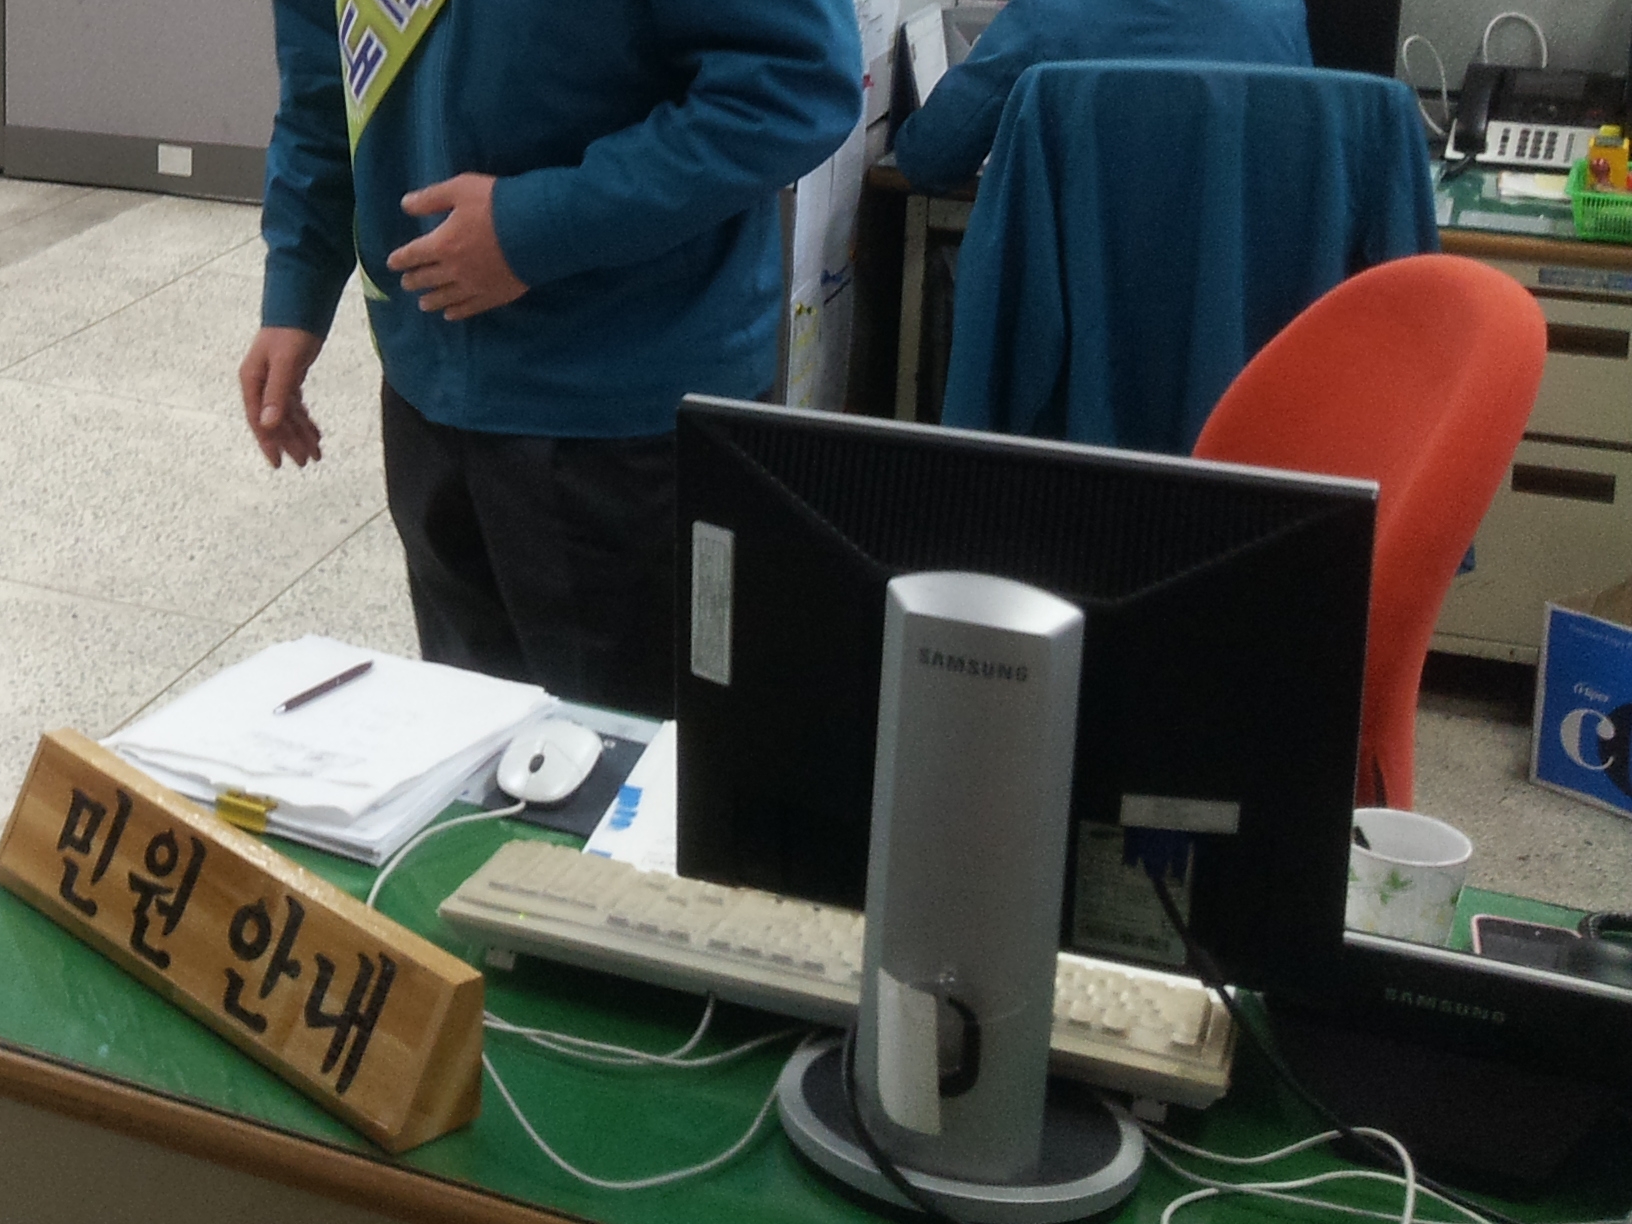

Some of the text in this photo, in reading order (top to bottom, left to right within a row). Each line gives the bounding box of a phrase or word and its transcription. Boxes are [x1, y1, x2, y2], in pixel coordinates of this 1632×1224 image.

[917, 646, 1029, 683] SAMSUNG
[56, 787, 398, 1096] 민원 안내
[1385, 986, 1506, 1025] SAMSUNG
